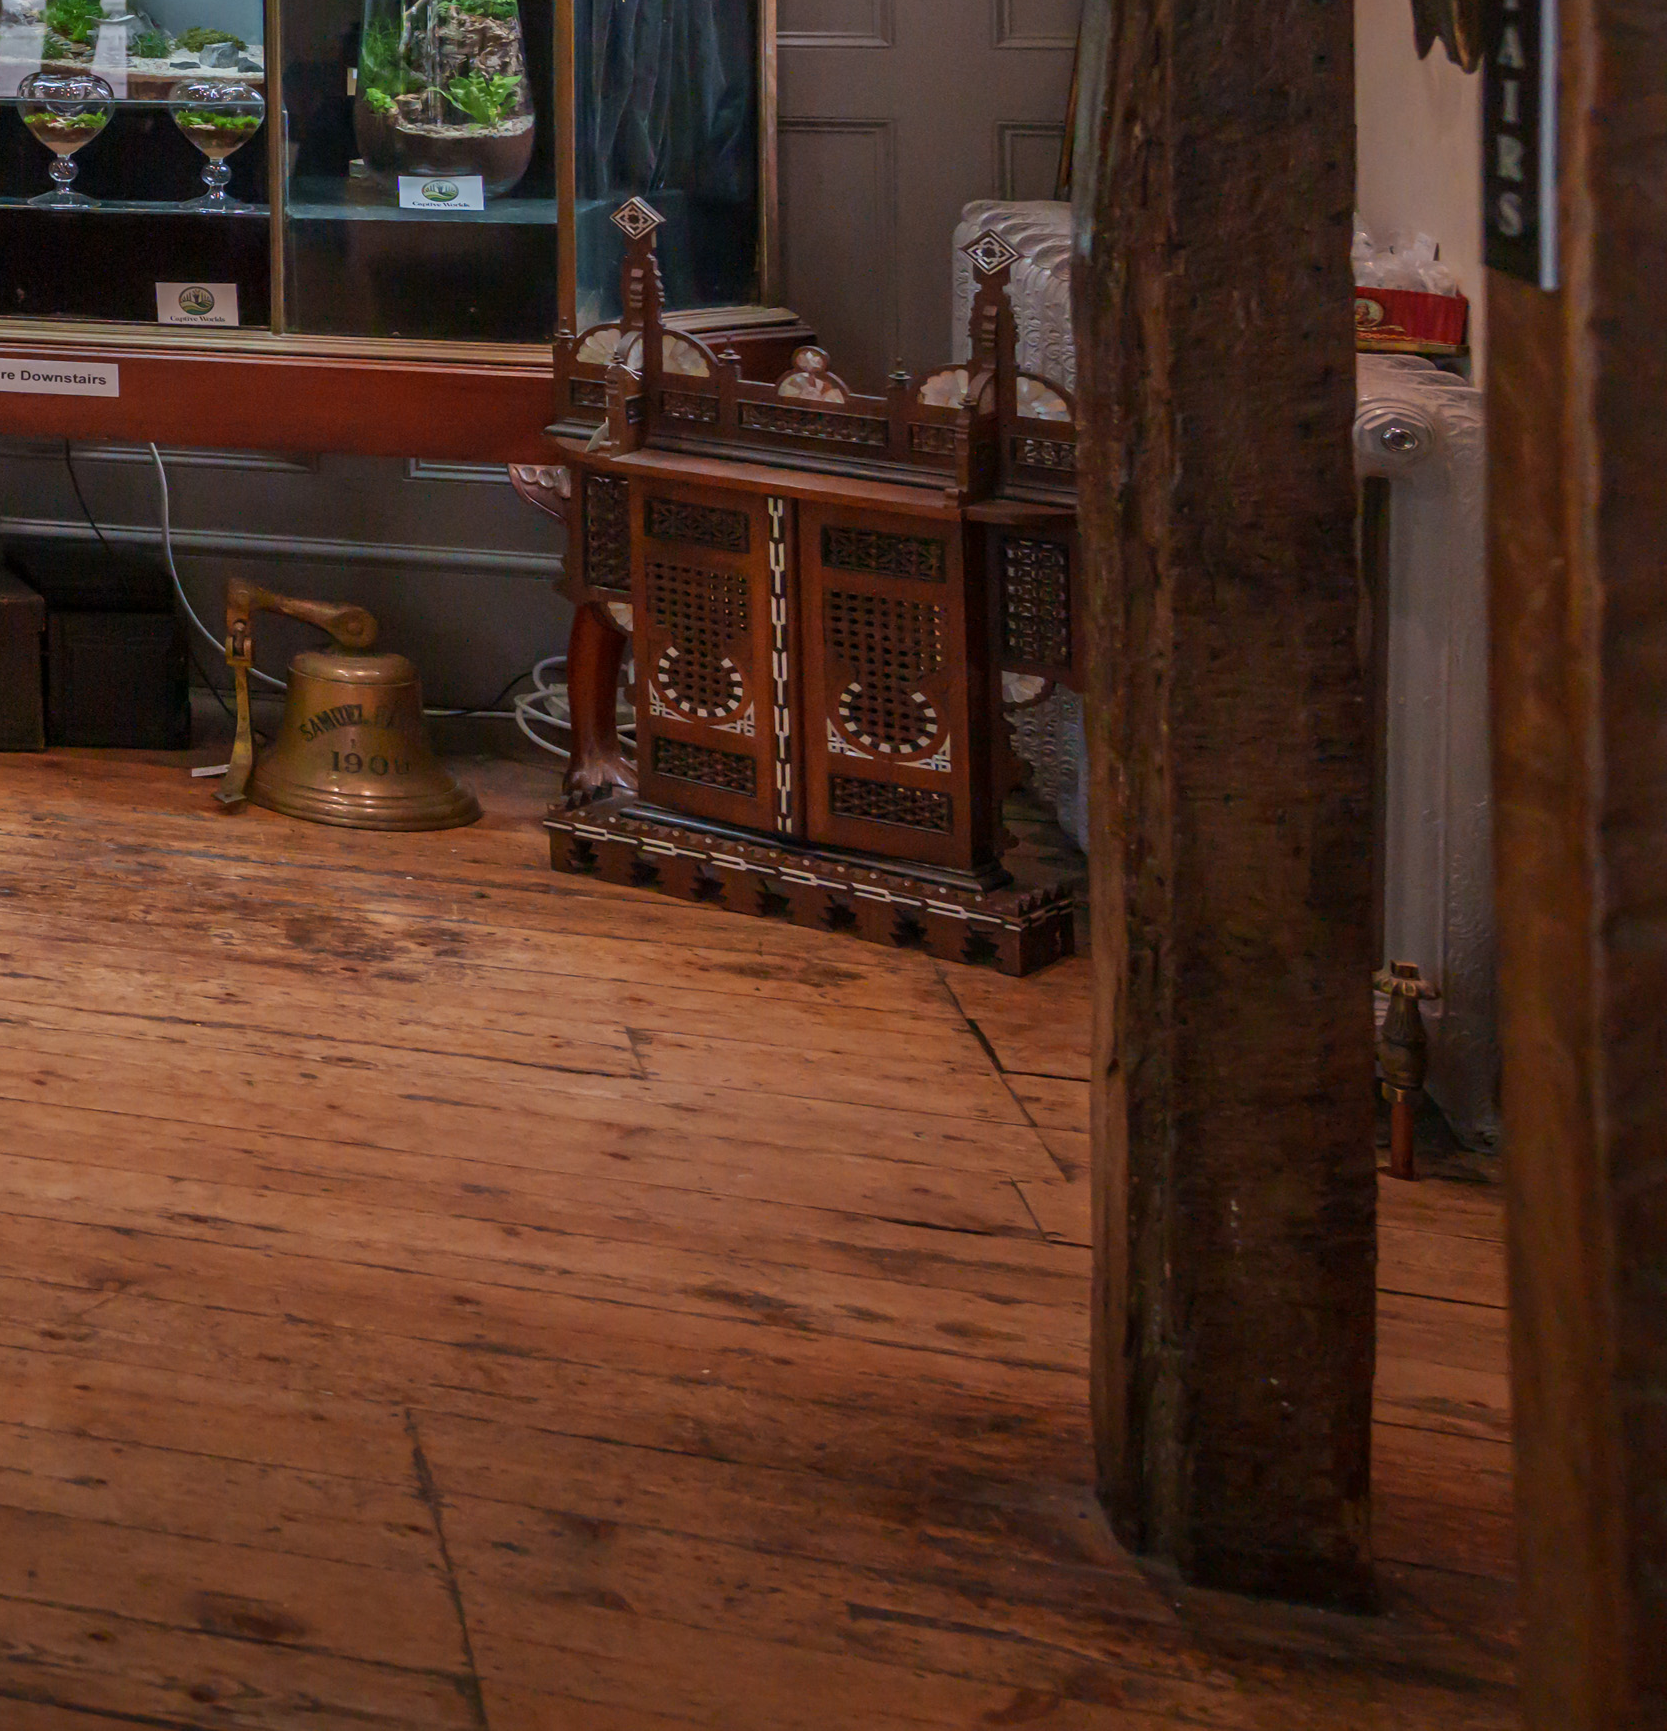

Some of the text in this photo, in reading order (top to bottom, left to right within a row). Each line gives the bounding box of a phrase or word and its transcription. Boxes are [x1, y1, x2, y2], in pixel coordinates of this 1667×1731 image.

[412, 200, 442, 208] Captive
[170, 314, 226, 324] Captive Worlds
[20, 370, 107, 386] Downstairs
[299, 704, 363, 742] SAMUEL
